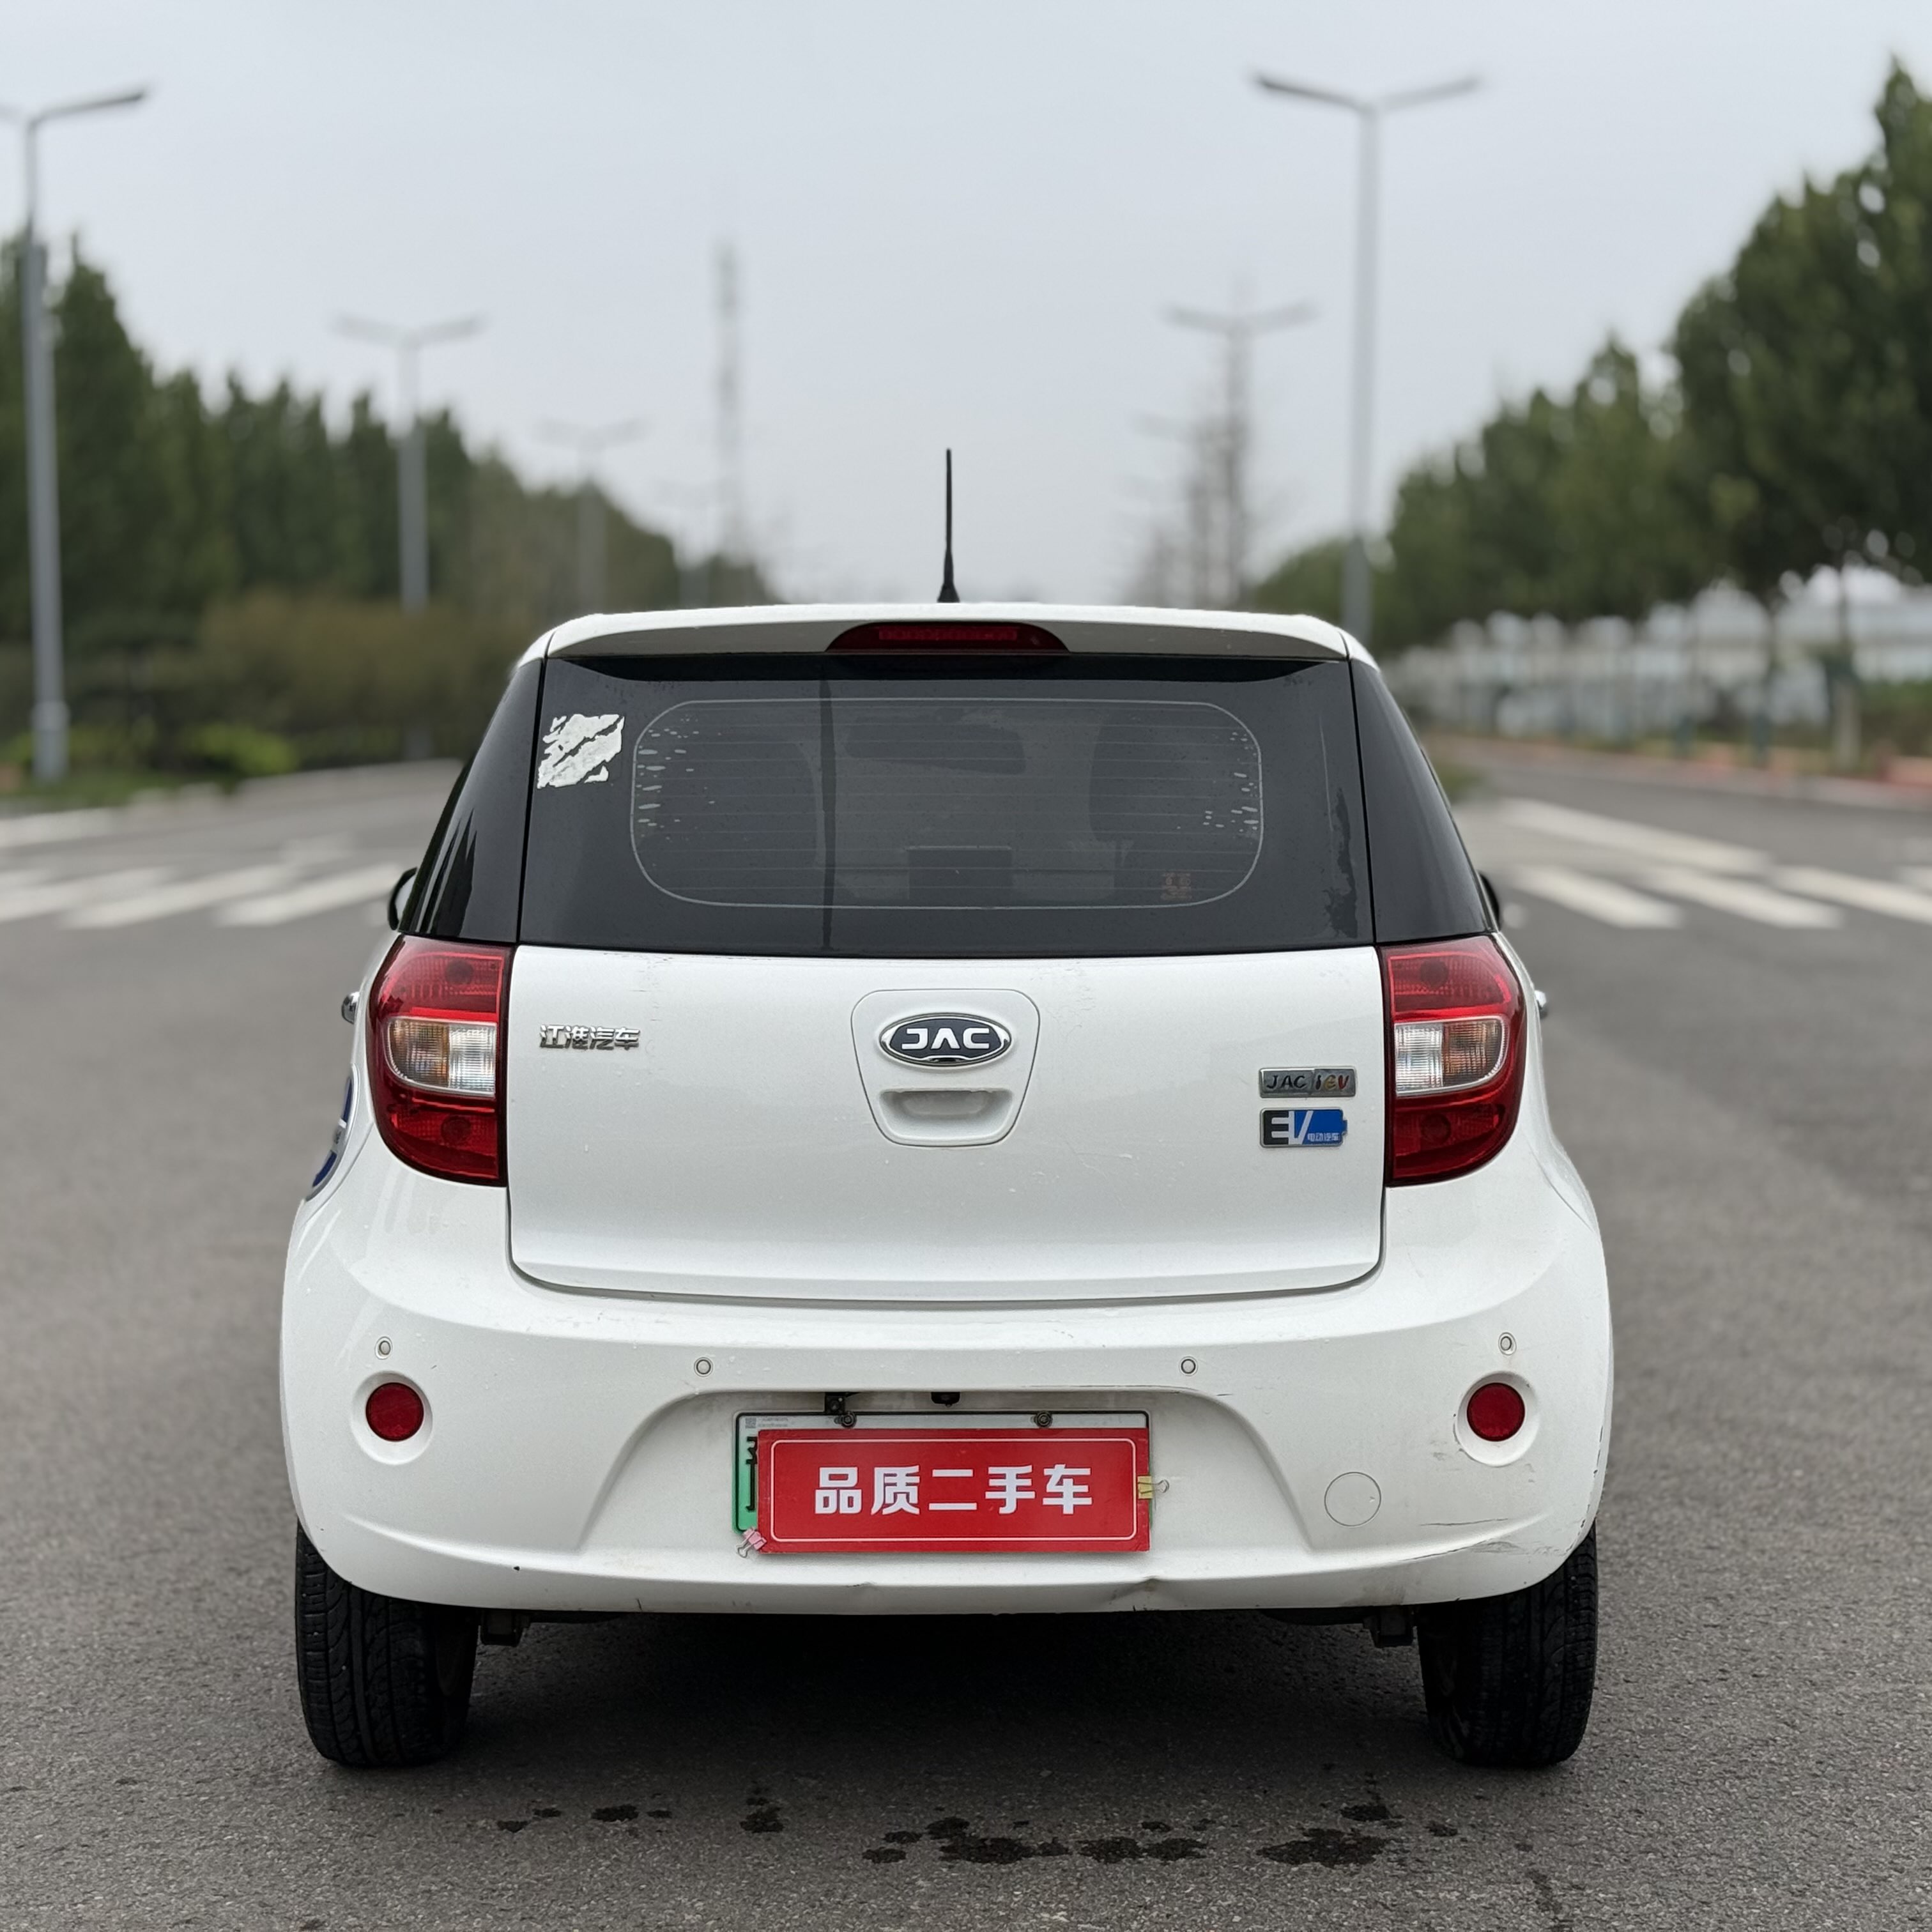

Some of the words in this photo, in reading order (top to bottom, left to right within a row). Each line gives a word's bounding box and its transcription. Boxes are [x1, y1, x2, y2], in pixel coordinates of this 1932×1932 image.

[539, 1024, 640, 1050] 江淮汽车
[901, 1027, 990, 1050] JAC
[1266, 1075, 1307, 1089] JAC
[1264, 1110, 1314, 1145] EV
[815, 1464, 1092, 1515] 品质二手车
